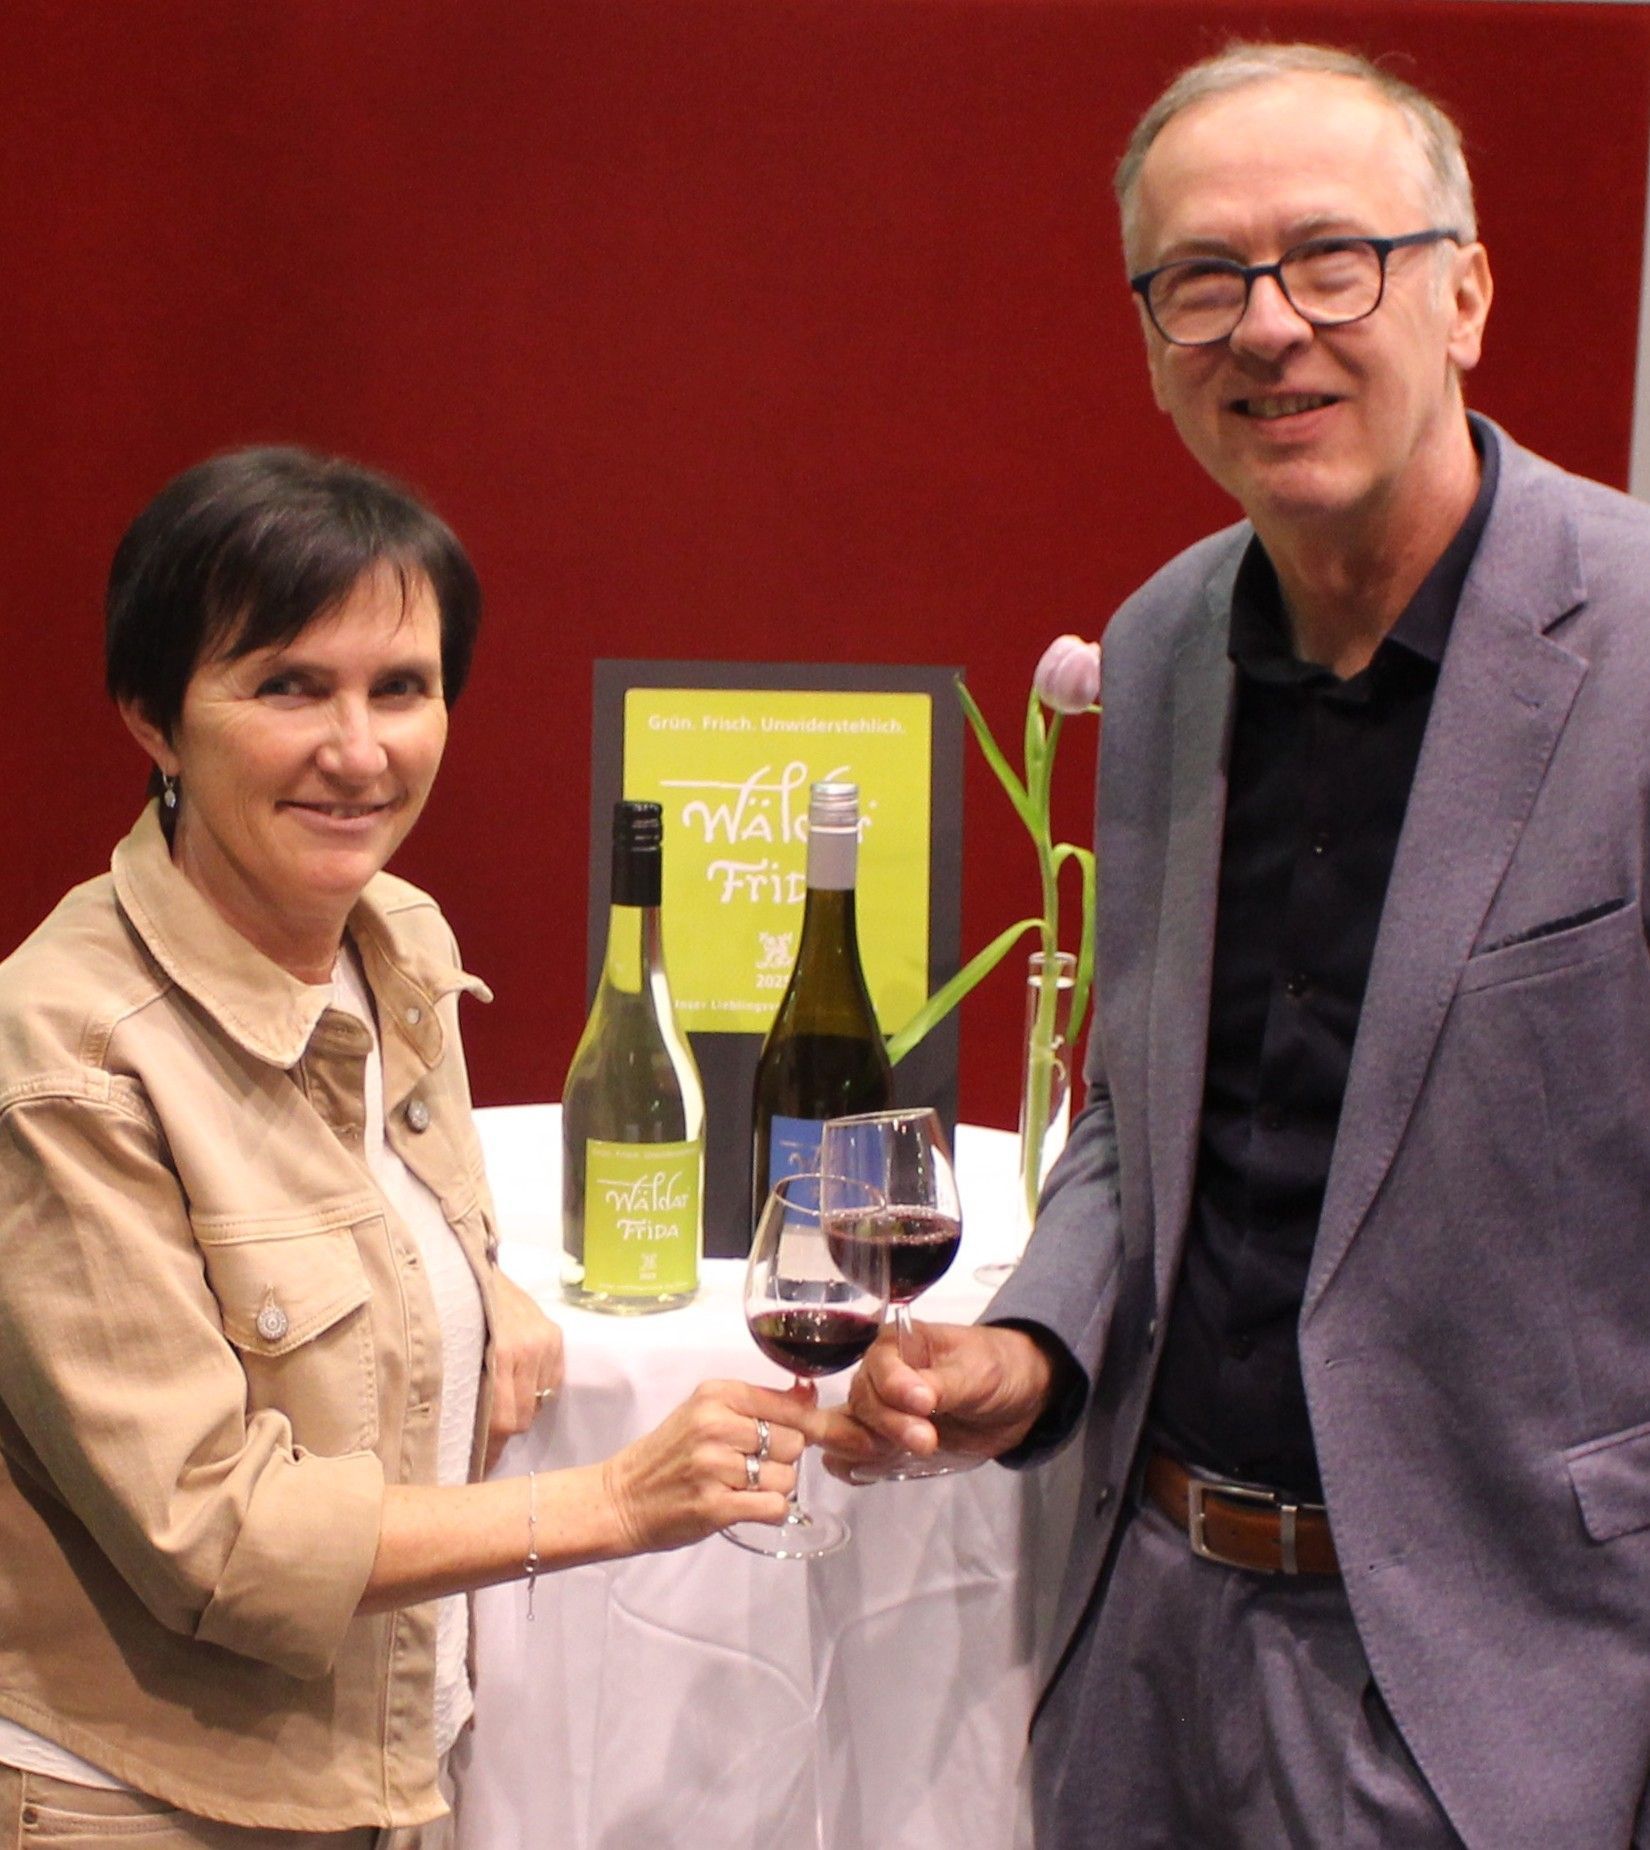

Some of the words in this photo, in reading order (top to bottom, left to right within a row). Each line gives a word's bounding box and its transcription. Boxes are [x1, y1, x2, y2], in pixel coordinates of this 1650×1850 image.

[648, 715, 694, 731] Grün.
[703, 715, 754, 732] Frisch.
[761, 717, 906, 734] Unwiderstehlich.
